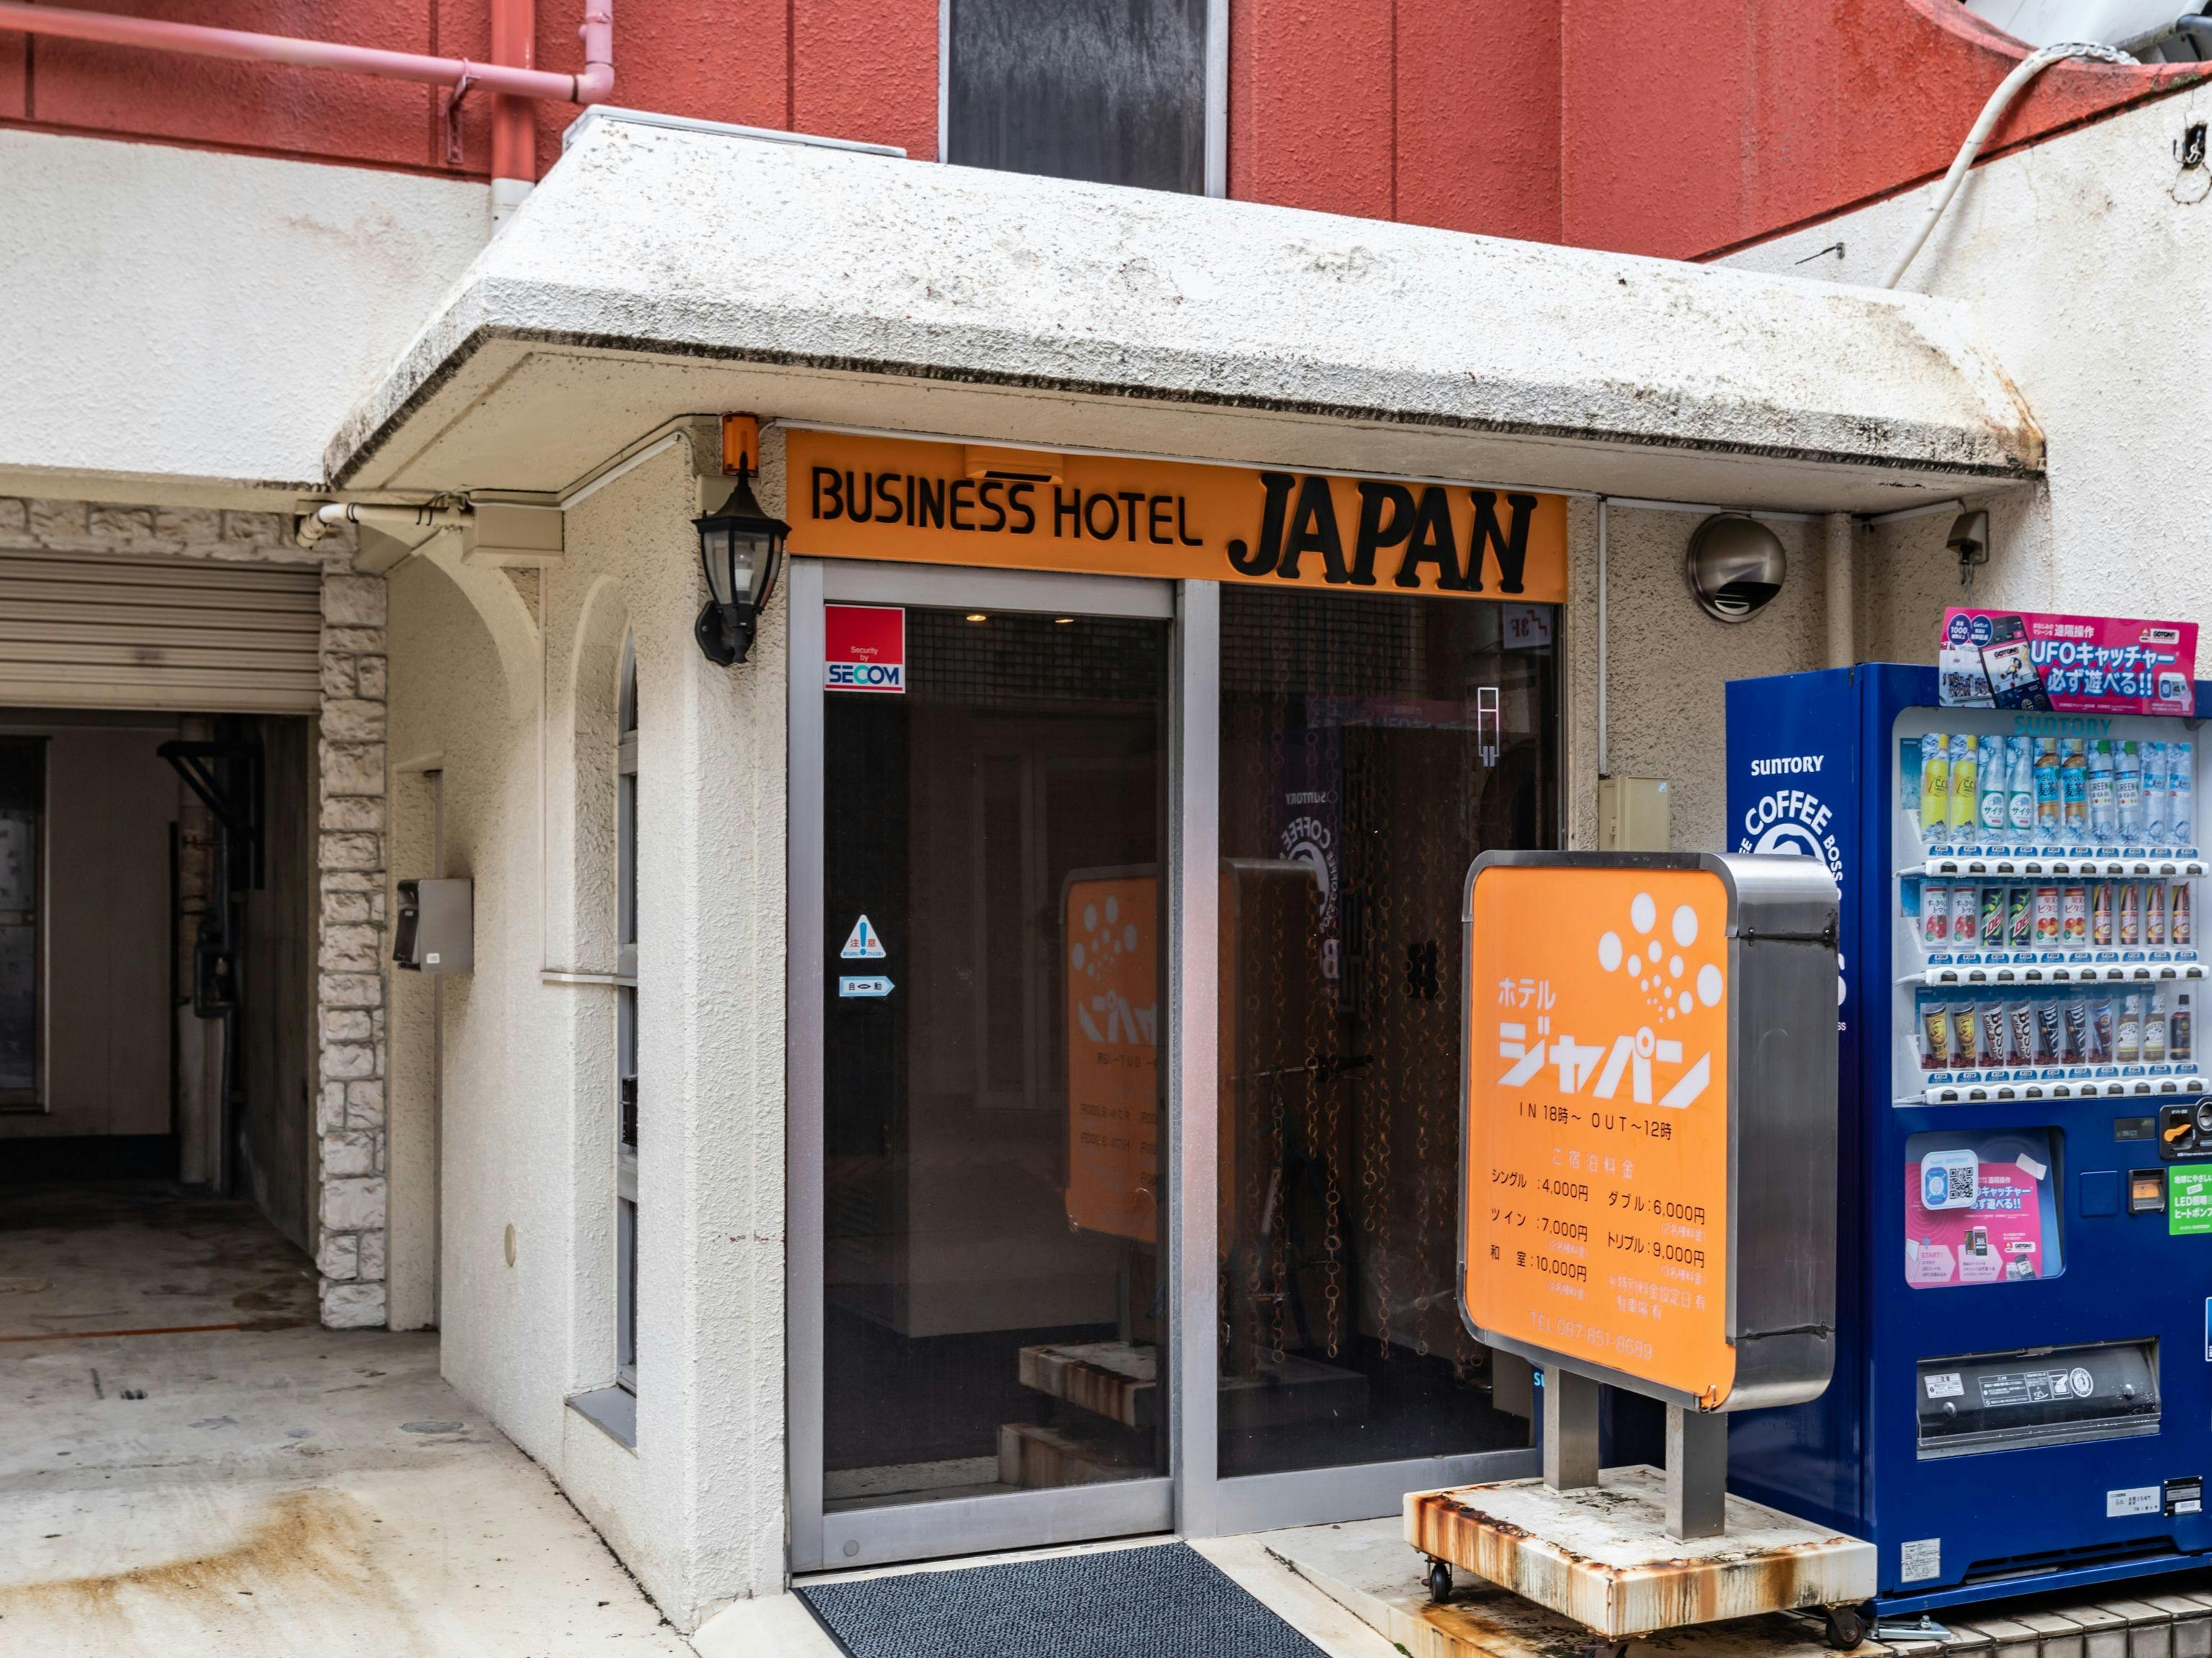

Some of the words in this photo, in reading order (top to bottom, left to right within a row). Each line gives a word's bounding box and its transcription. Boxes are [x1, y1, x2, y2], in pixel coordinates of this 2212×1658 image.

[812, 466, 1035, 535] BUSINESS
[1053, 486, 1203, 548] HOTEL
[1227, 472, 1538, 594] JAPAN
[1950, 626, 1968, 635] 1000
[851, 645, 879, 656] Security
[859, 653, 869, 663] by
[2031, 640, 2175, 669] UFOキャッチャー
[829, 664, 899, 685] SECOM
[2048, 667, 2152, 696] 必ず遊べる!!
[2016, 715, 2113, 738] SUNTORY
[1751, 755, 1824, 776] SUNTORY
[1745, 789, 1833, 835] COFFEE
[1497, 976, 1556, 1011] ホテル
[1495, 1015, 1710, 1110] ジャパン
[1519, 1102, 1537, 1118] IN
[1492, 1169, 1527, 1189] シングル
[1491, 1208, 1526, 1227] ツイン
[1529, 1310, 1553, 1333] TEL
